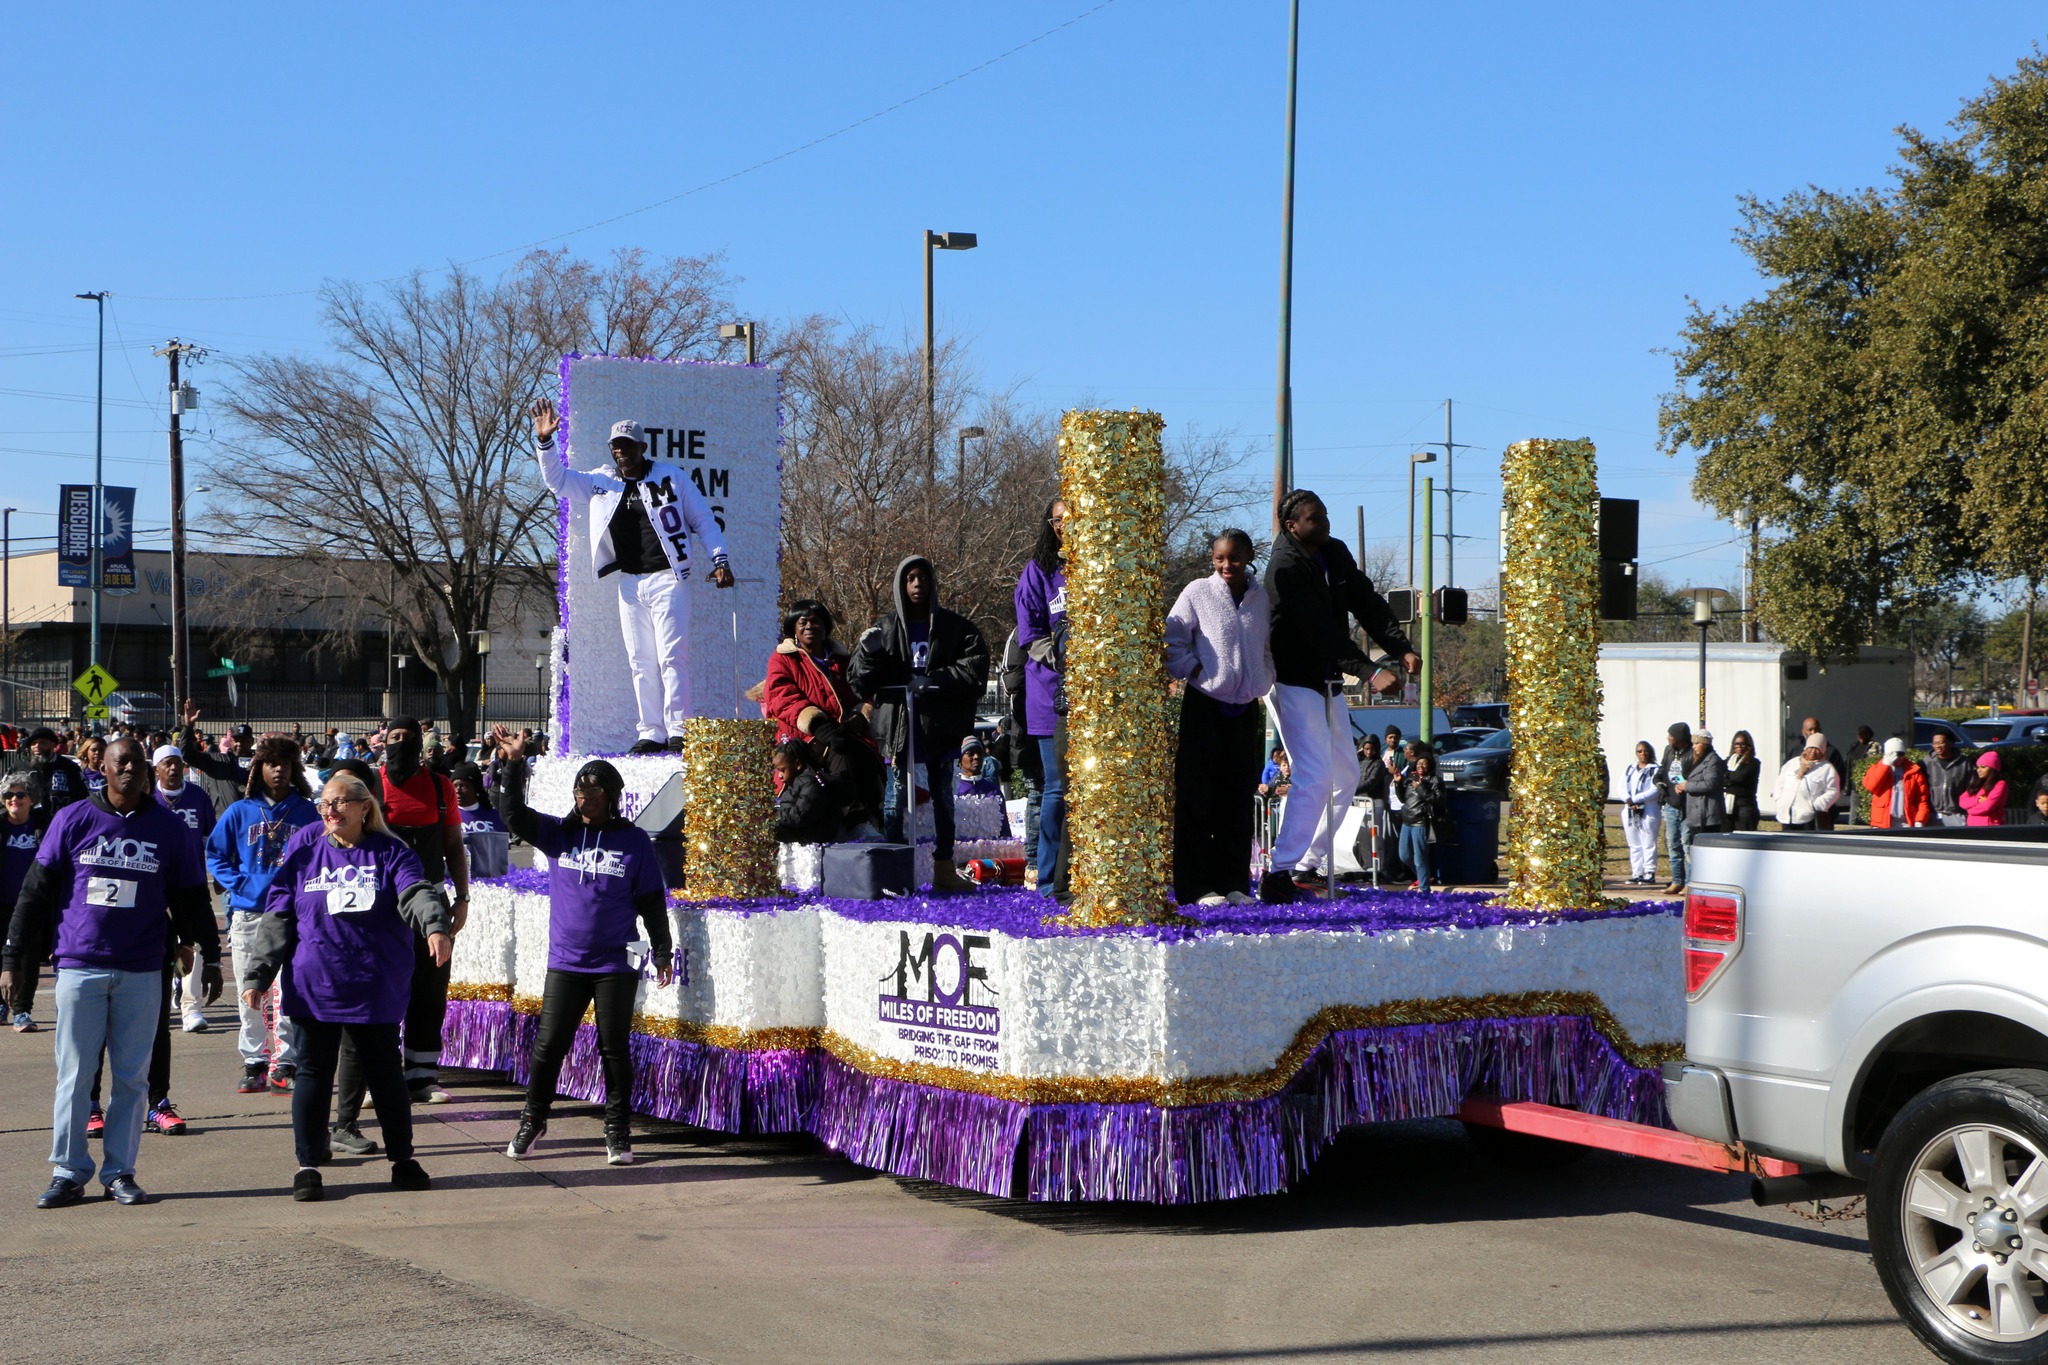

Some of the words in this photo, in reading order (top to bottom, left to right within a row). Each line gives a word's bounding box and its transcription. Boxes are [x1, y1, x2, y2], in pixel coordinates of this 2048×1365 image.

[616, 424, 632, 434] MOF
[644, 428, 705, 459] THE
[70, 491, 89, 557] DESCUBRE
[646, 475, 688, 562] MOF
[104, 574, 111, 585] 31
[112, 574, 120, 585] DE
[146, 569, 205, 596] Vita
[172, 808, 197, 822] OF
[461, 821, 494, 832] MOF
[95, 835, 158, 862] MOF
[81, 856, 106, 864] MILES
[121, 861, 158, 871] FREEDOM
[321, 864, 376, 884] MOF
[104, 883, 119, 902] 2
[344, 891, 357, 908] 2
[897, 930, 991, 1007] MOF
[881, 1000, 915, 1022] MILES
[916, 1005, 933, 1023] OF
[936, 1007, 997, 1032] FREEDOM
[899, 1028, 936, 1044] BRIDGING
[973, 1038, 999, 1053] FROM
[946, 1049, 957, 1062] TO
[961, 1053, 998, 1070] PROMISE
